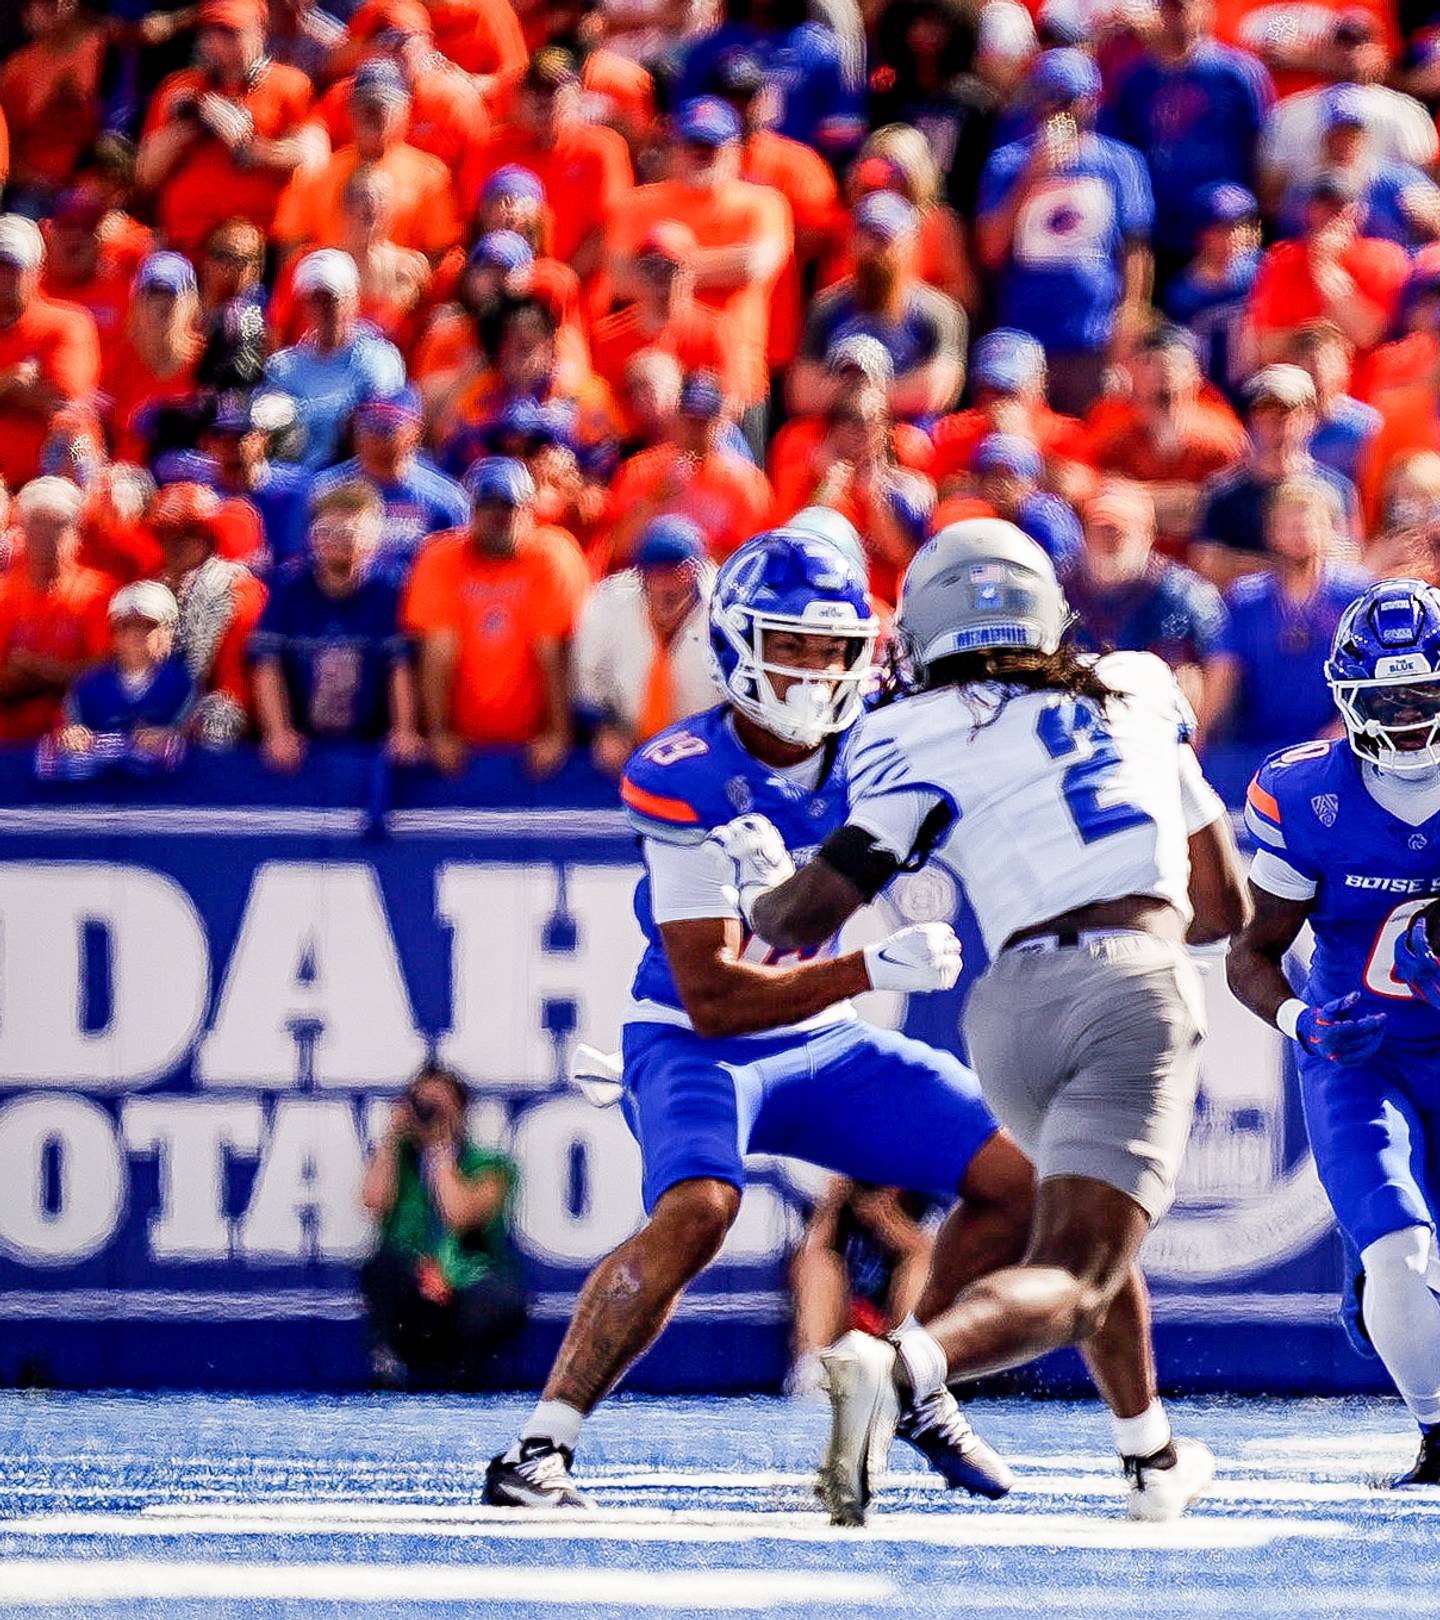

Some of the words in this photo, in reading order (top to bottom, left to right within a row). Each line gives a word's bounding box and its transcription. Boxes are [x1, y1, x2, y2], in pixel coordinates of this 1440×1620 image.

[1389, 661, 1414, 673] BLUE
[641, 730, 709, 766] 19
[1037, 700, 1156, 846] 2
[1345, 873, 1424, 894] BOISE
